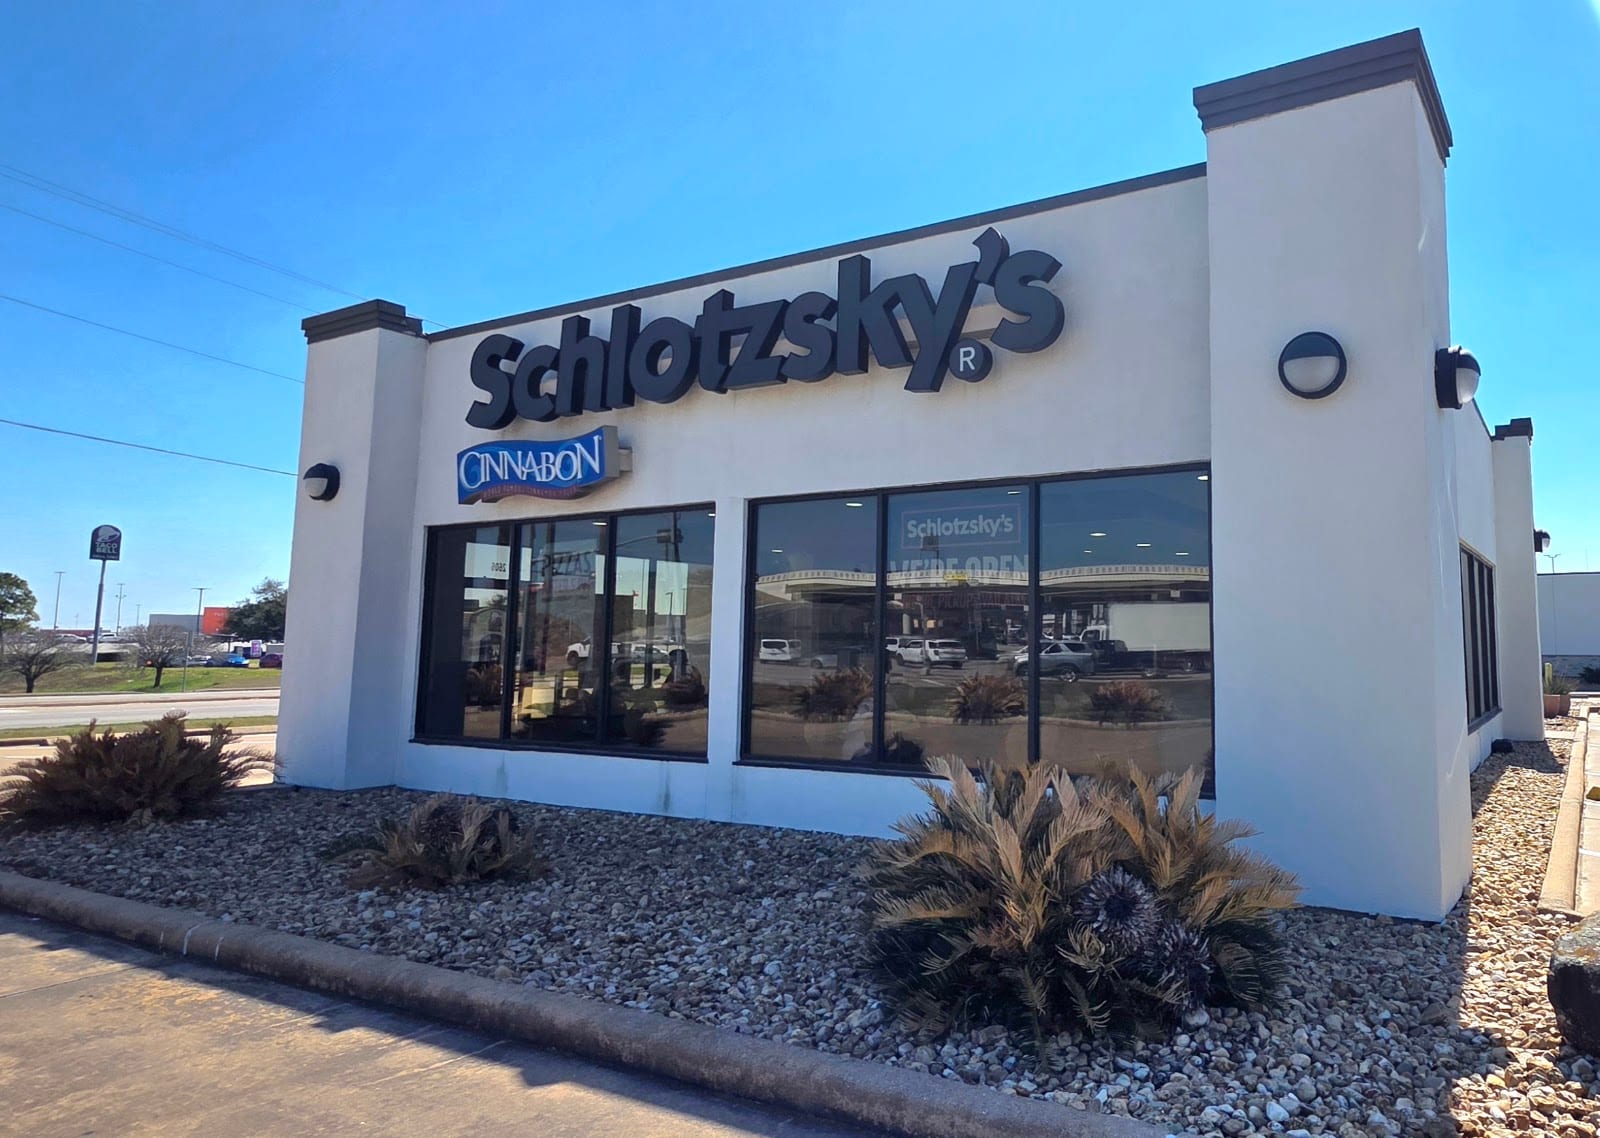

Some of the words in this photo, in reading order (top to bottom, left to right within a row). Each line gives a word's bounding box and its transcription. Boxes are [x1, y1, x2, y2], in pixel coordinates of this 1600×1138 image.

[466, 227, 1064, 430] Schlotzsky's
[459, 434, 601, 489] CINNABON
[907, 514, 1013, 538] Schlotzsky's
[965, 554, 1029, 586] OPEN
